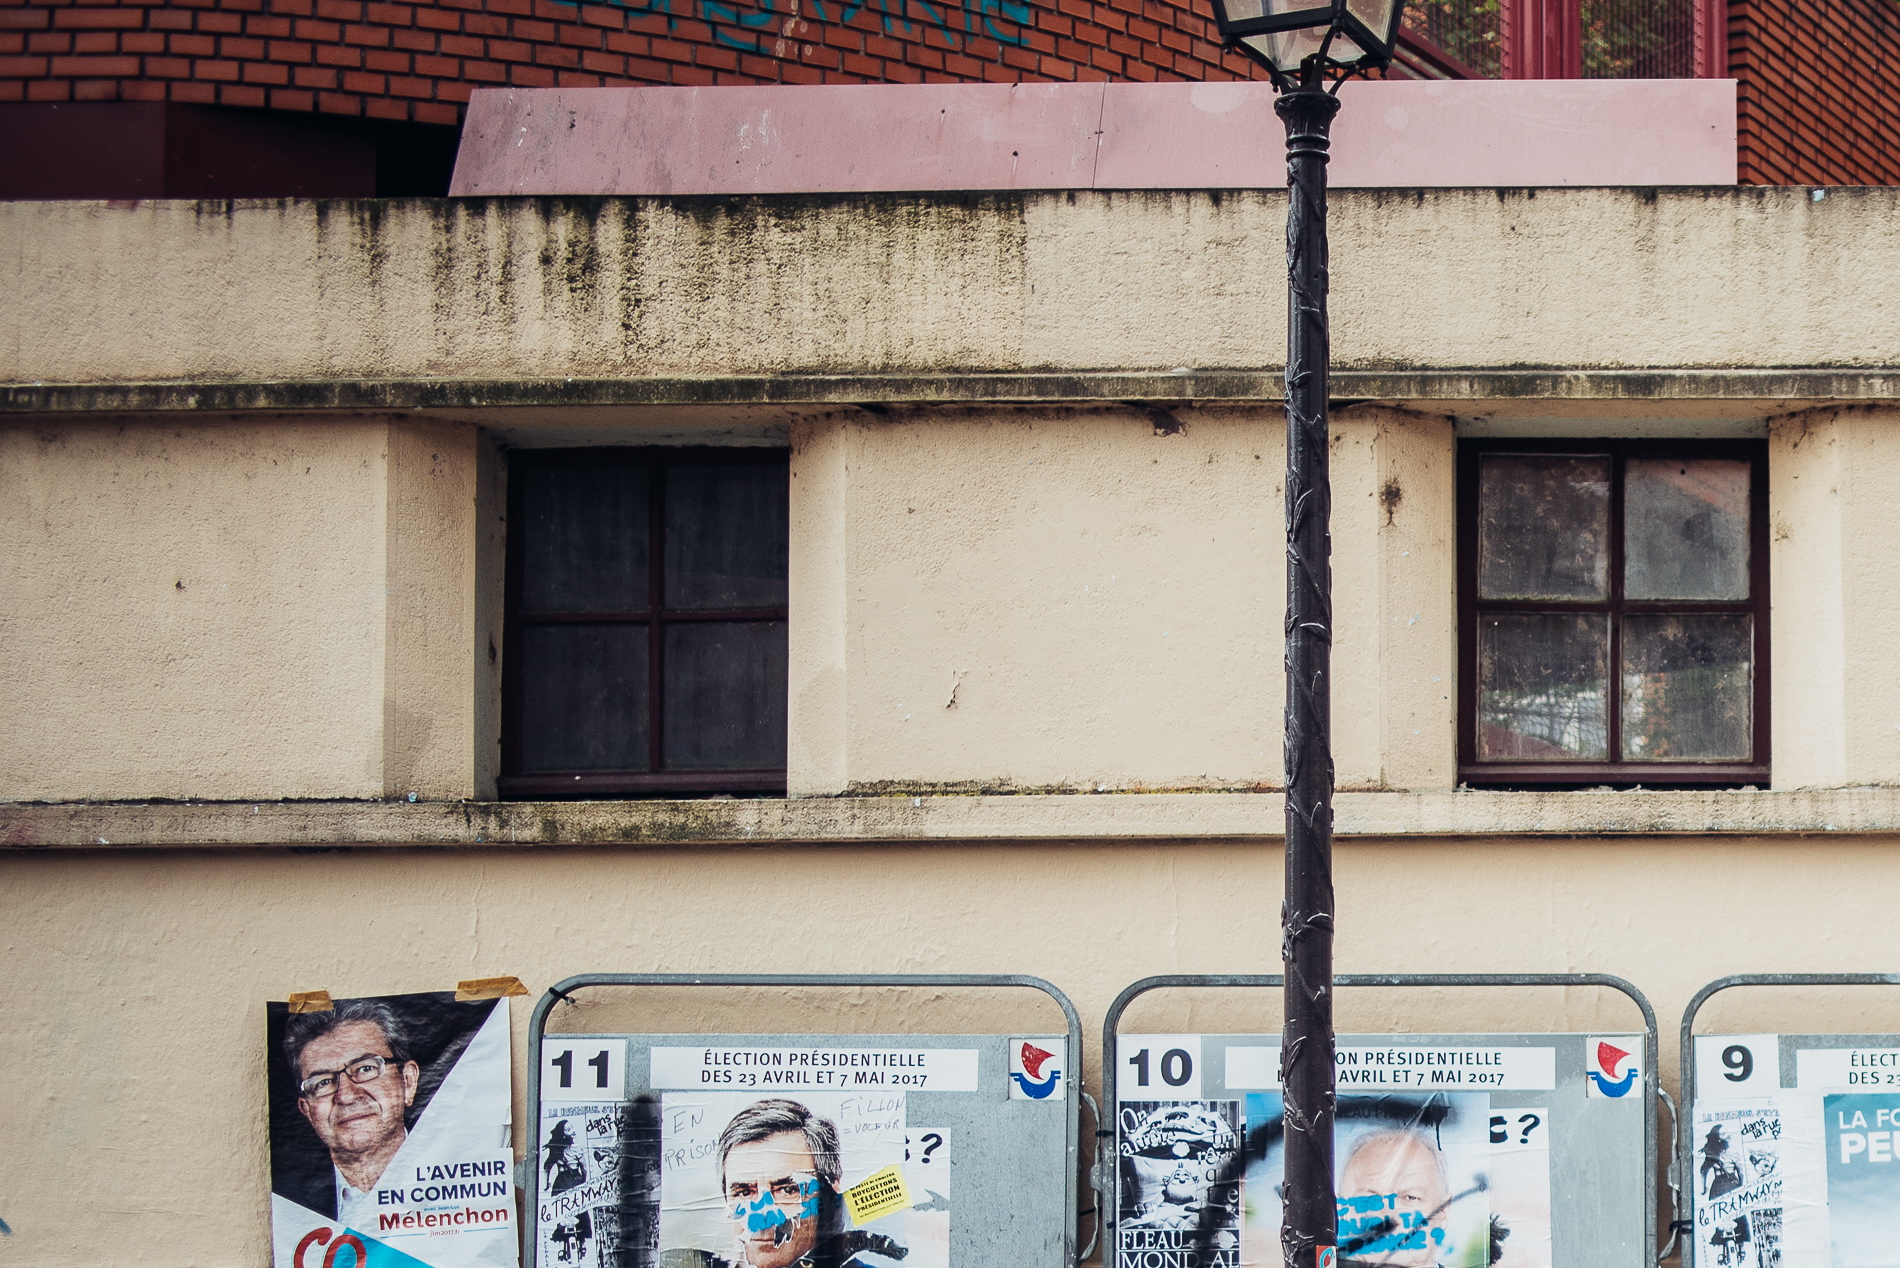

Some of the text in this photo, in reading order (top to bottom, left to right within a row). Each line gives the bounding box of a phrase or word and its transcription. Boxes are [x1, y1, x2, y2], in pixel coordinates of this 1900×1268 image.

[704, 1049, 926, 1067] ÉLECTION PRÉSIDENTIELLE
[1365, 1049, 1502, 1065] PRÉSIDENTIELLE
[1721, 1045, 1754, 1082] 9
[552, 1050, 609, 1089] 11
[701, 1070, 927, 1087] DES 23 AVRIL ET 7 MAI 2017
[1129, 1049, 1192, 1087] 10
[1339, 1069, 1505, 1086] AVRIL ET 7 MAI 2017
[1849, 1071, 1880, 1085] DES
[1120, 1107, 1149, 1135] On
[1839, 1110, 1868, 1130] LA
[416, 1160, 506, 1182] L'AVENIR
[377, 1181, 507, 1205] EN COMMUN
[379, 1208, 508, 1231] Mélenchon
[1120, 1230, 1183, 1250] FLEAU
